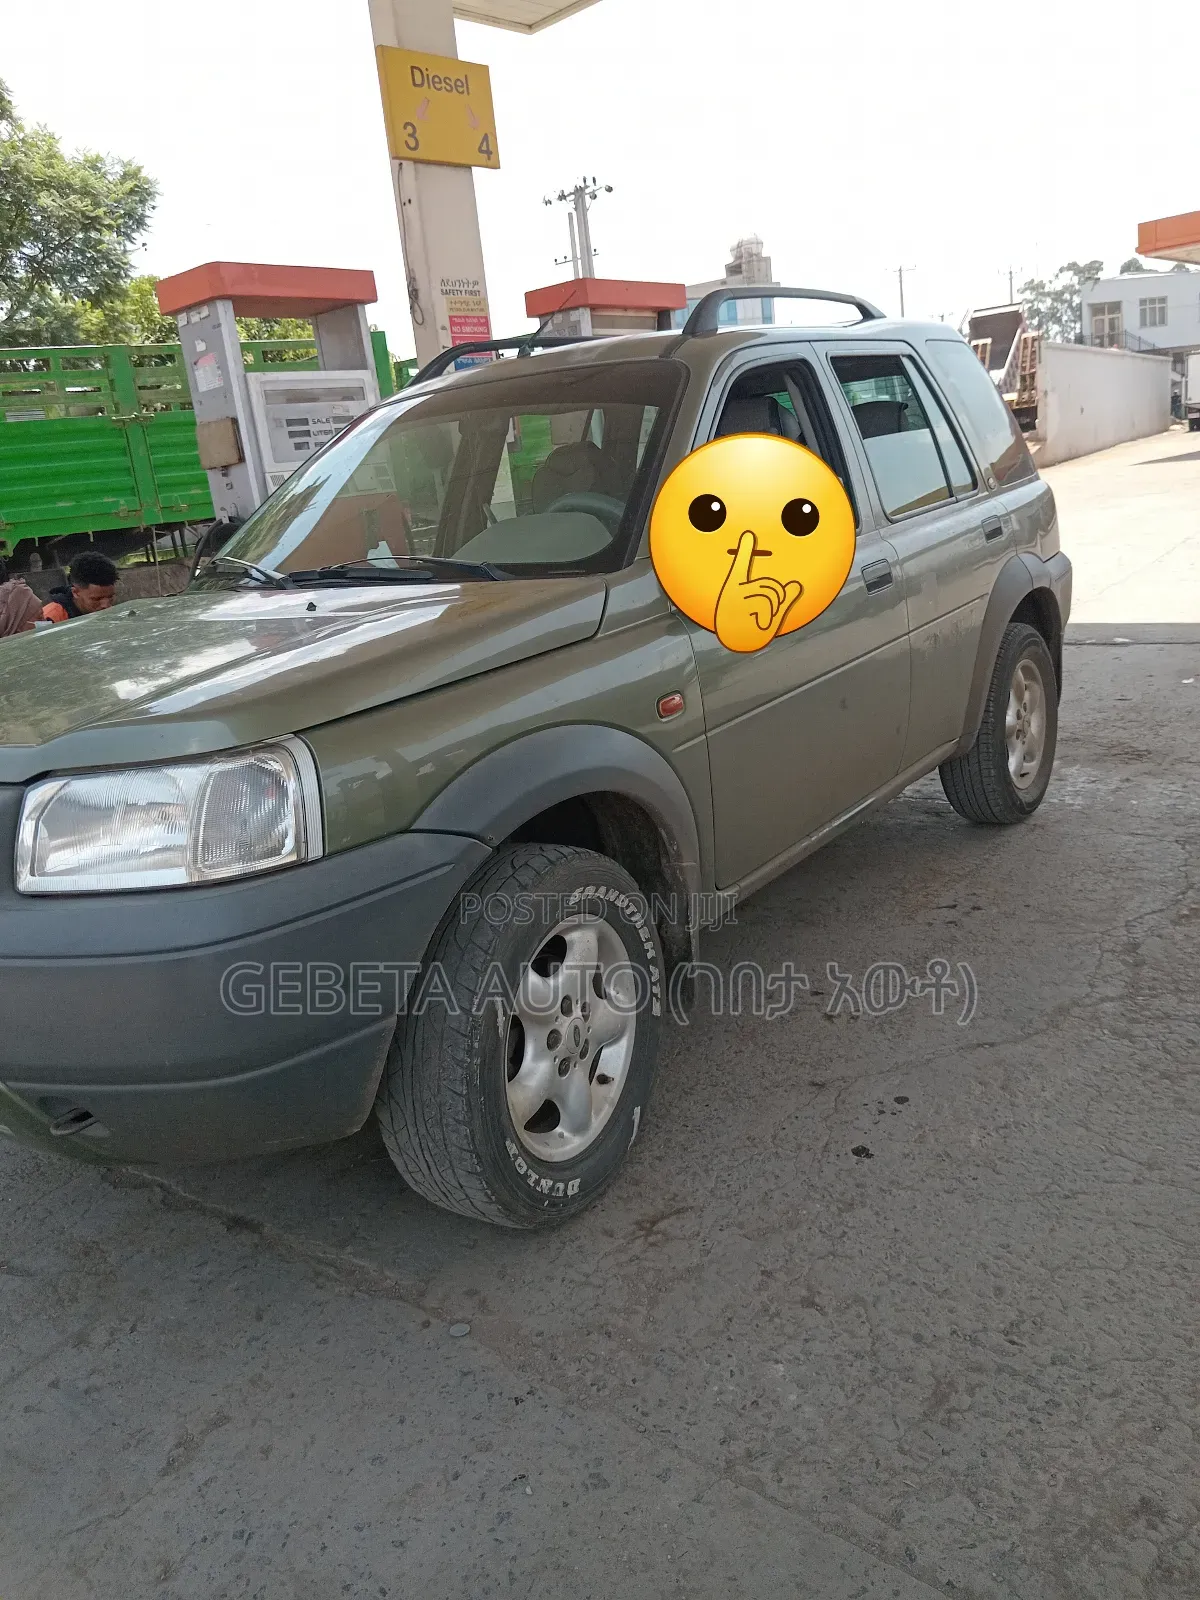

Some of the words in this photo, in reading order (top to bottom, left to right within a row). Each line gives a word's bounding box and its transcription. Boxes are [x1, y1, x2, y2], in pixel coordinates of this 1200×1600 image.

[410, 65, 470, 96] Diesel
[403, 121, 420, 151] 3
[477, 132, 493, 161] 4
[440, 288, 463, 297] SAFETY
[464, 289, 481, 297] FIRST
[451, 325, 461, 333] NO
[461, 325, 488, 334] SMOKING
[505, 1138, 581, 1198] DUNLOP
